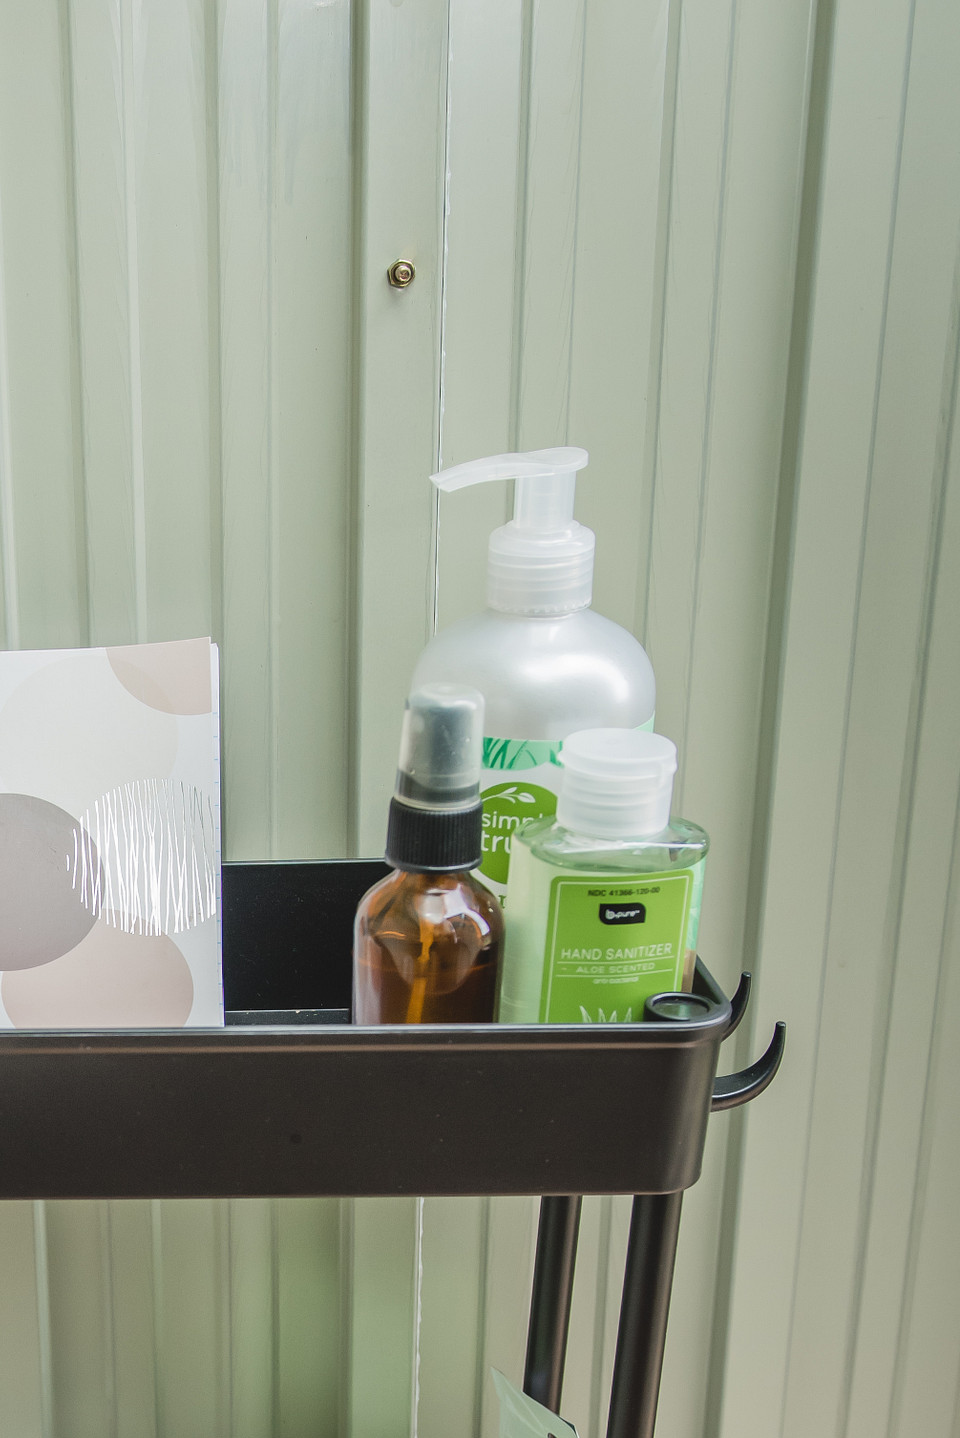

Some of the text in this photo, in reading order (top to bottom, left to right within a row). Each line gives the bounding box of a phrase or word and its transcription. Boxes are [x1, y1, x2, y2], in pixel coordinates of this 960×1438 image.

[560, 942, 673, 961] HAND SANITIZER
[576, 962, 656, 974] ALOE SCENTED
